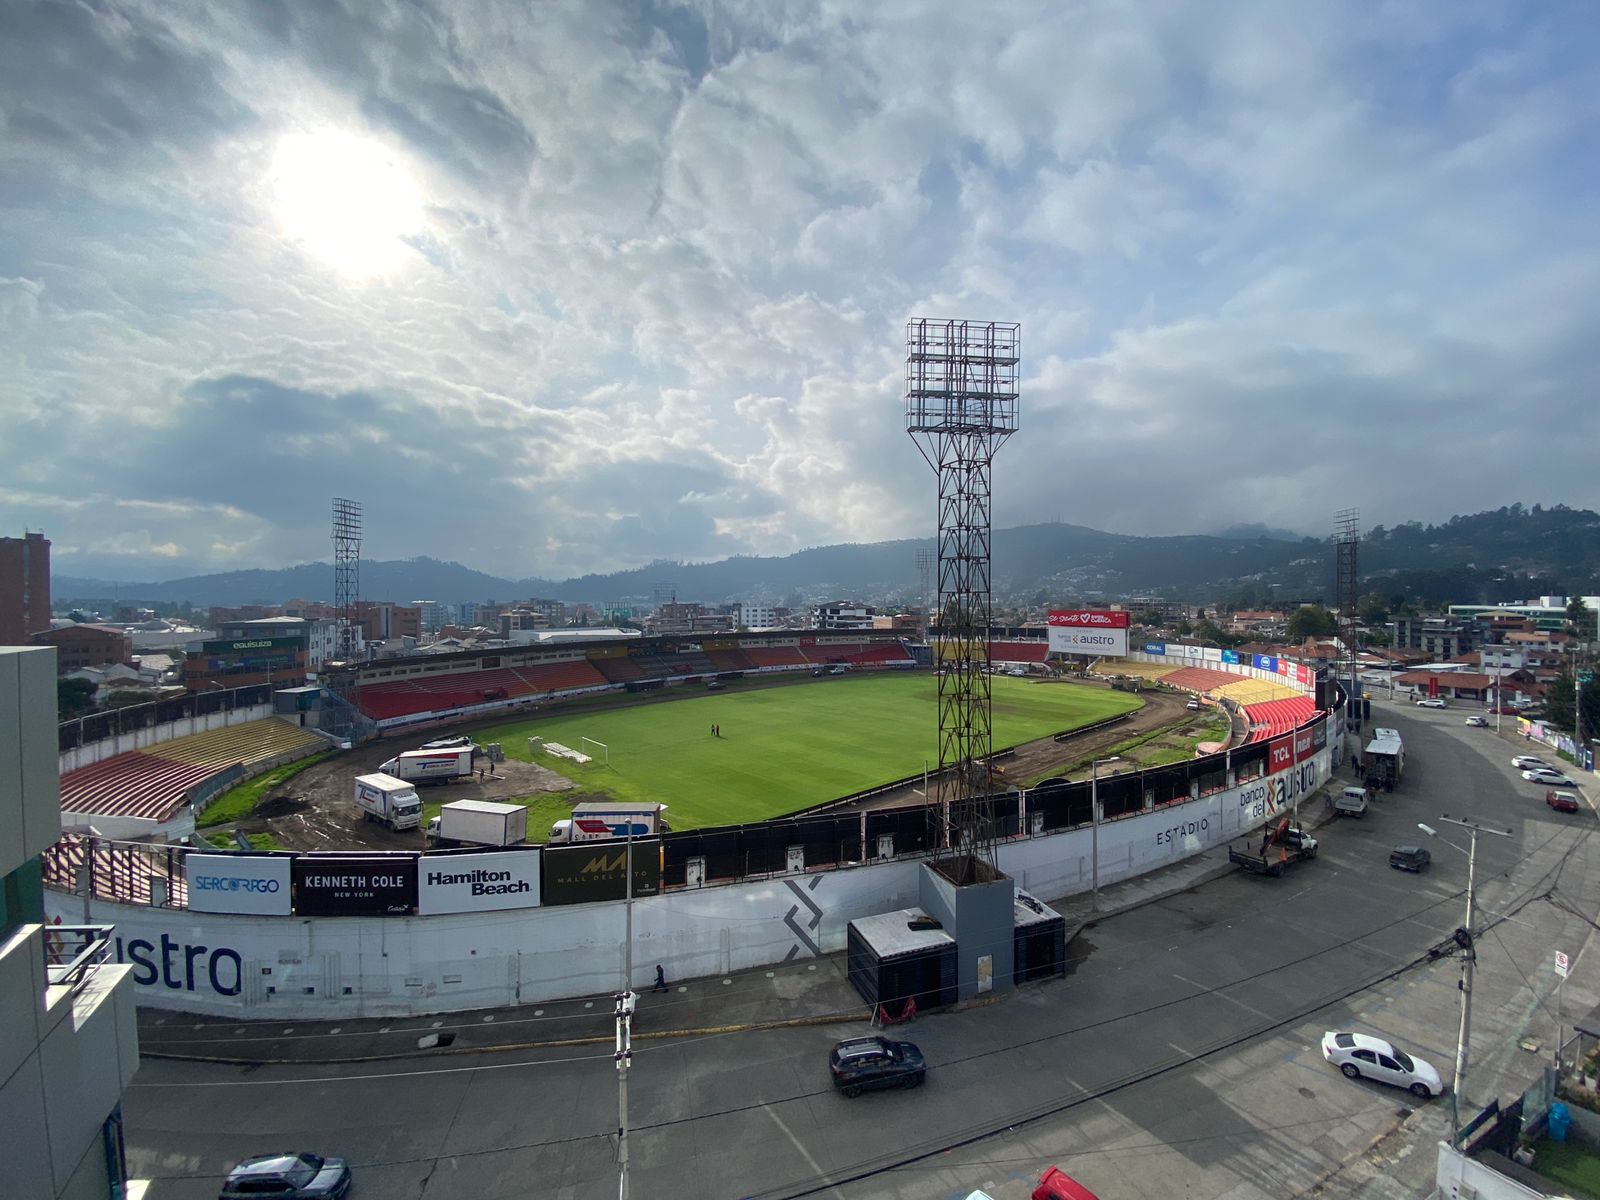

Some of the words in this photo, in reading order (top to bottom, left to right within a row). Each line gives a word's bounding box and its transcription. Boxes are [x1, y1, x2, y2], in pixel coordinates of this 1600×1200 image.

[1080, 635, 1114, 645] austro
[1273, 746, 1290, 764] TCL
[1240, 785, 1265, 806] banco
[1252, 801, 1265, 817] del
[1156, 818, 1208, 845] ESTADIO
[305, 876, 367, 888] KENNETH
[371, 876, 404, 888] COLE
[427, 869, 511, 886] Hamilton
[621, 870, 647, 879] ATO
[471, 880, 530, 896] Beach
